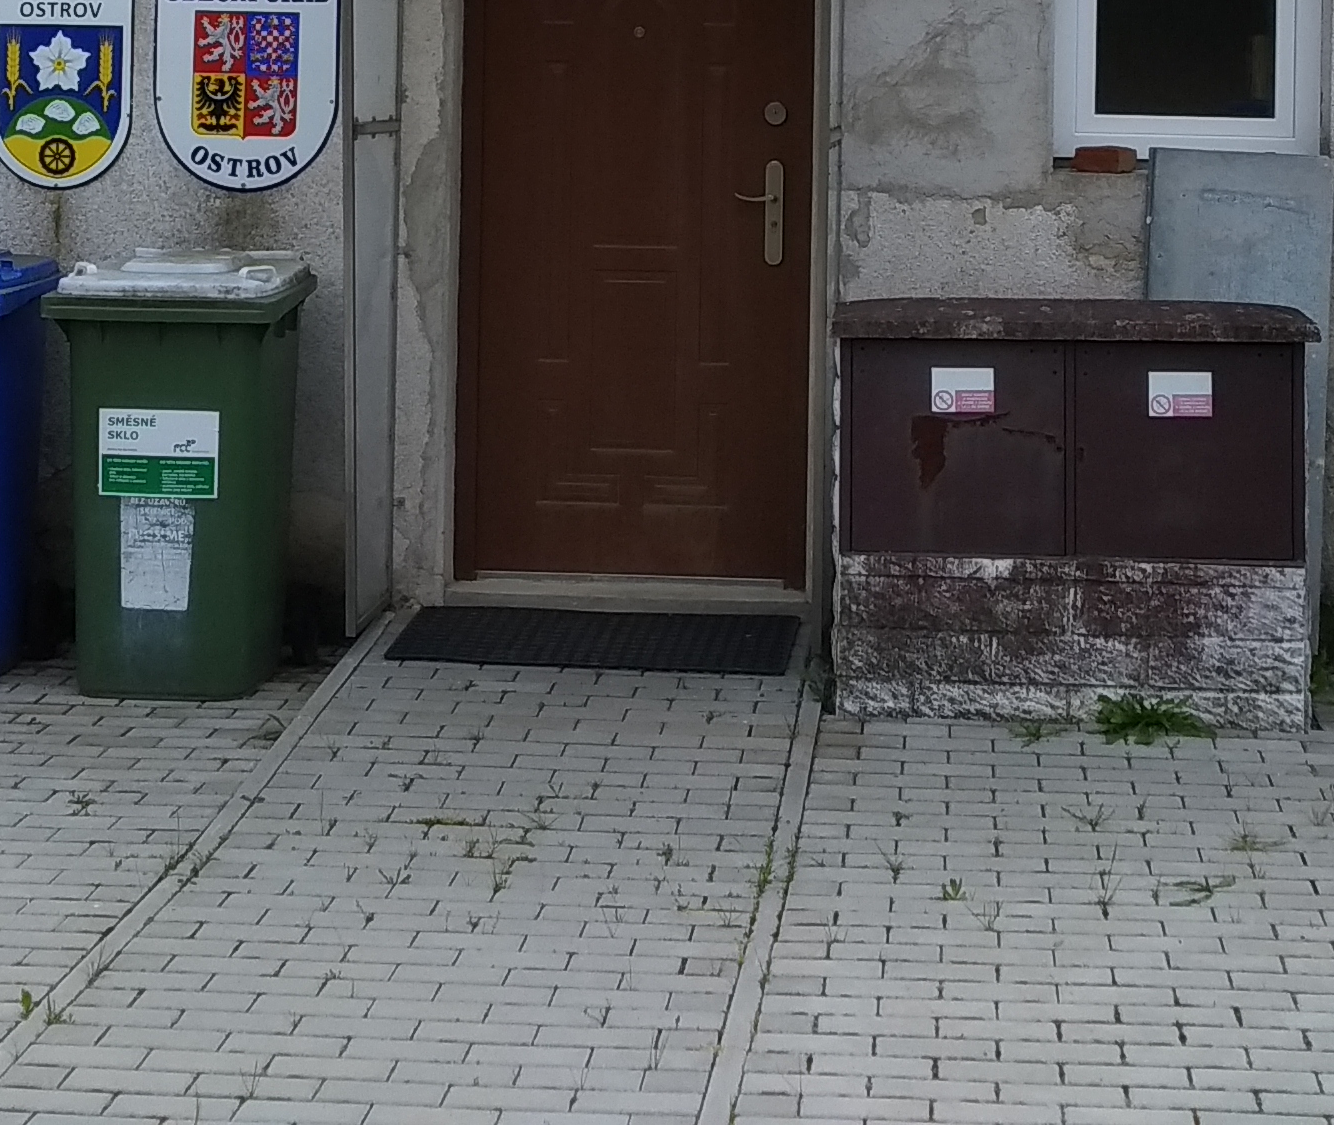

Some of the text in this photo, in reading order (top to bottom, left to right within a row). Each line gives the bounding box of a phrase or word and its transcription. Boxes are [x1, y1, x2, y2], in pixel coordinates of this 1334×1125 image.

[19, 1, 103, 19] OSTROV
[190, 144, 299, 179] OSTROV
[107, 414, 157, 428] SMĚSNÉ
[107, 430, 139, 441] SKLO
